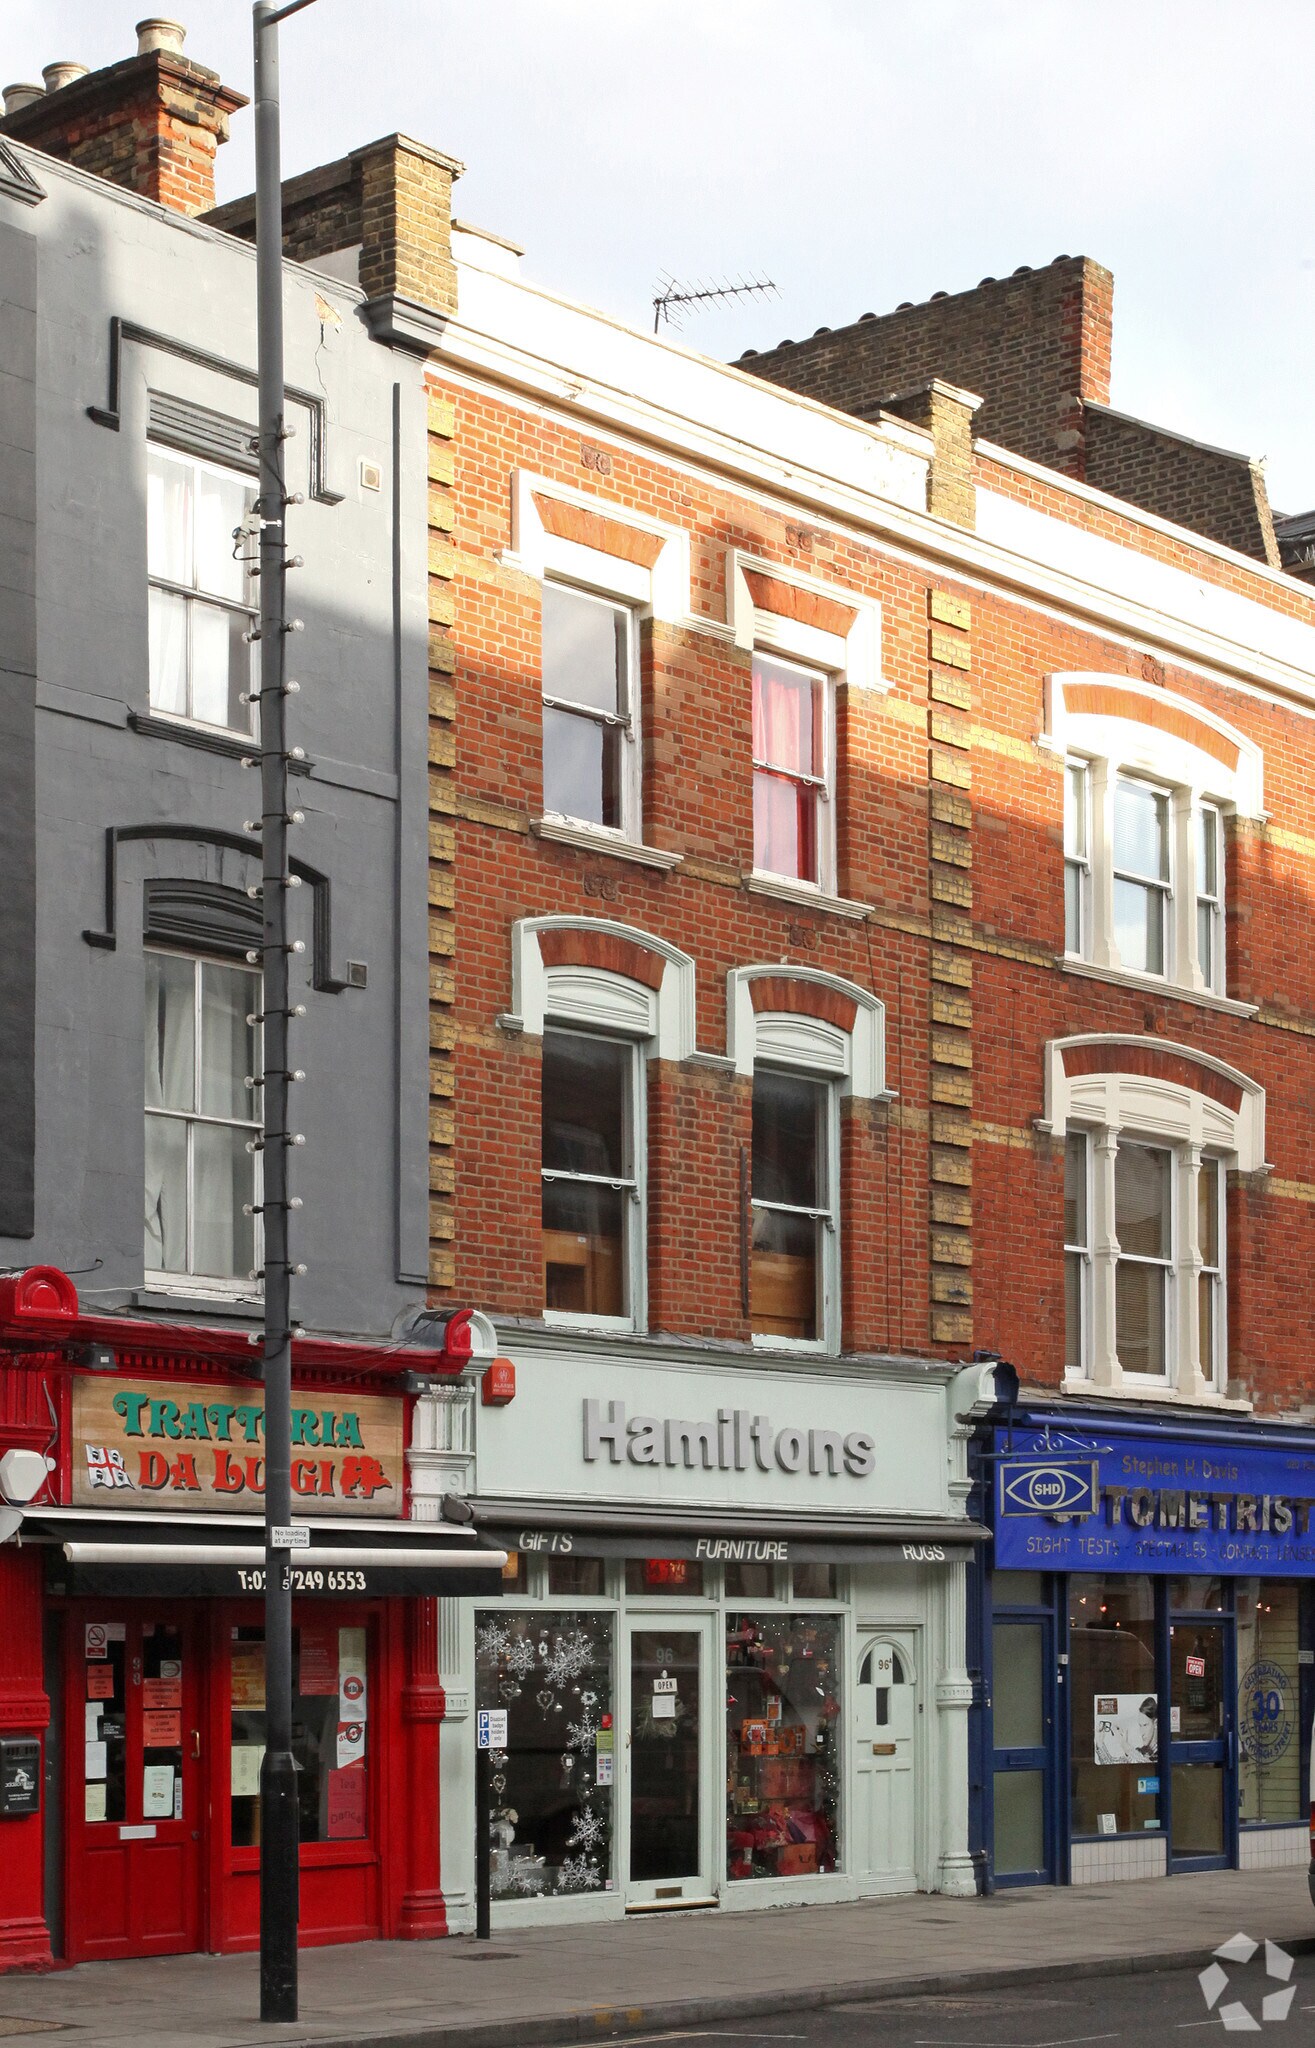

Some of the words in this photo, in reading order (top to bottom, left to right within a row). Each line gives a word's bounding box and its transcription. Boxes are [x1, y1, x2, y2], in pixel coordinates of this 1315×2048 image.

[113, 1391, 364, 1449] TRATTRIA
[582, 1398, 877, 1477] Hamiltons
[138, 1450, 201, 1491] DA
[211, 1448, 335, 1497] LUGI
[1122, 1455, 1179, 1479] Stephen
[1203, 1459, 1238, 1480] Davis
[1034, 1483, 1060, 1495] SHD
[518, 1531, 573, 1553] GIFTS
[695, 1539, 789, 1561] FURNITURE
[901, 1543, 946, 1562] RUGS
[1026, 1536, 1071, 1554] SIGHT
[1078, 1538, 1120, 1556] TESTS
[1135, 1540, 1207, 1558] SPECTACLES
[1220, 1543, 1270, 1560] CONTACT
[290, 1570, 324, 1590] 249
[327, 1571, 367, 1590] 6553
[656, 1647, 674, 1664] 96
[1188, 1663, 1202, 1675] OPEN
[657, 1681, 673, 1690] OPEN
[1251, 1690, 1280, 1720] 30
